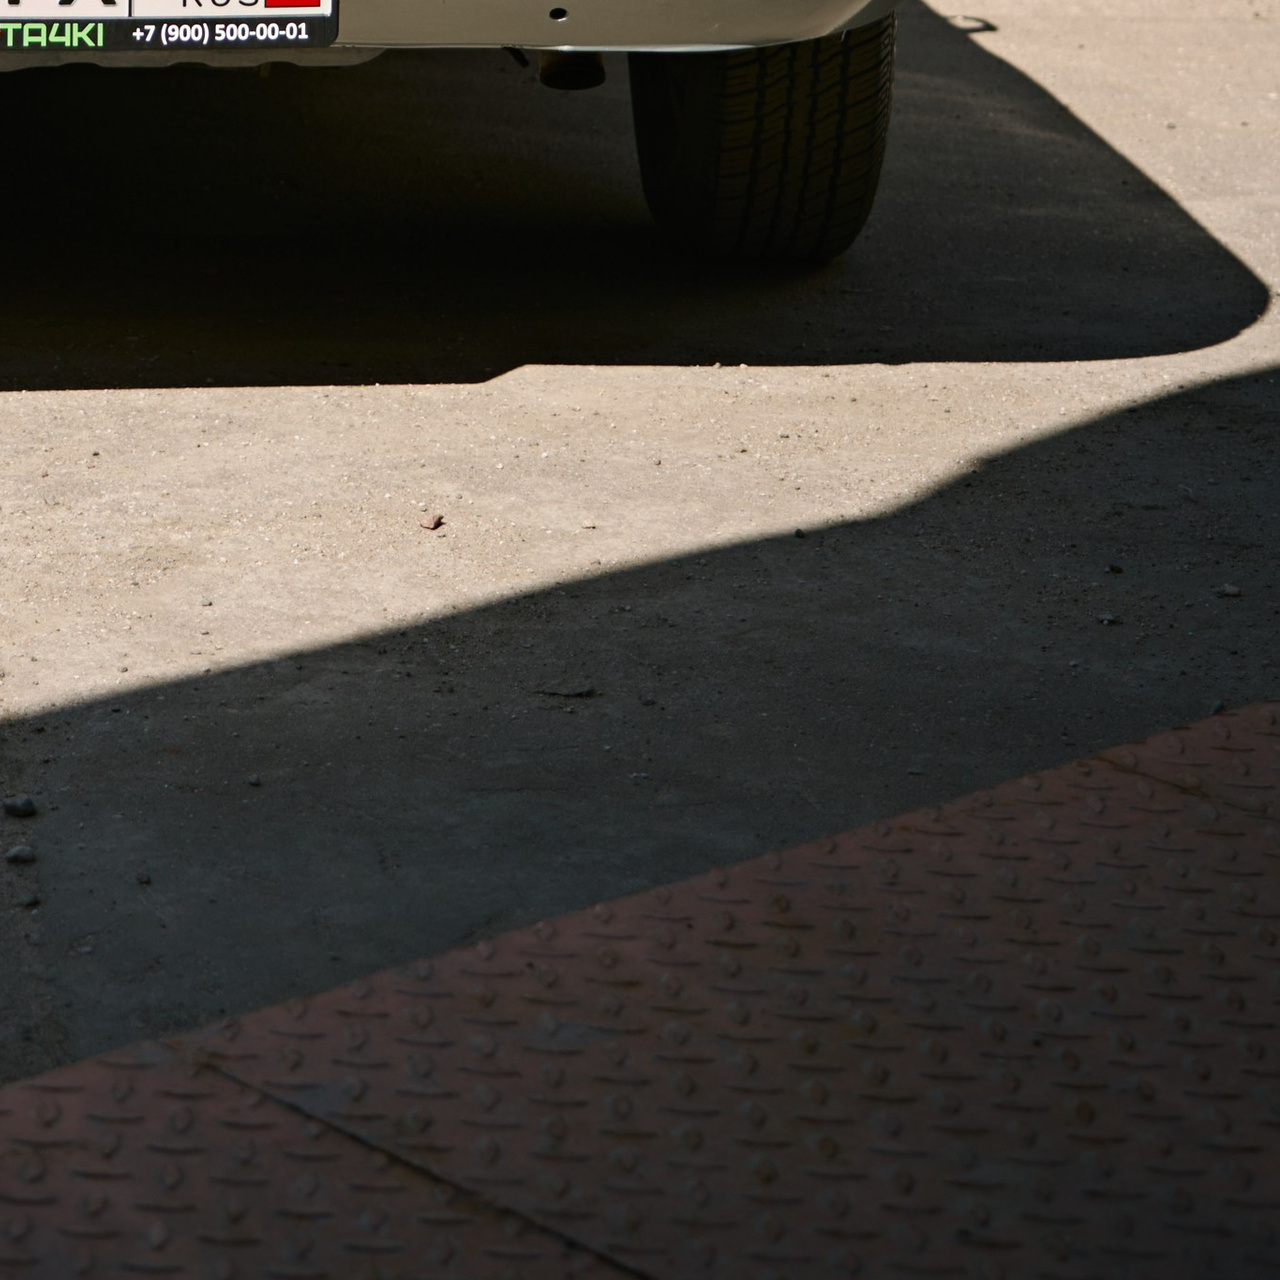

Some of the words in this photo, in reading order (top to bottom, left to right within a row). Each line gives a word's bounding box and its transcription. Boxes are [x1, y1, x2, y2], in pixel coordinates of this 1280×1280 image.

[132, 24, 156, 41] +7
[160, 22, 210, 46] (900)
[214, 22, 309, 41] 500-00-01
